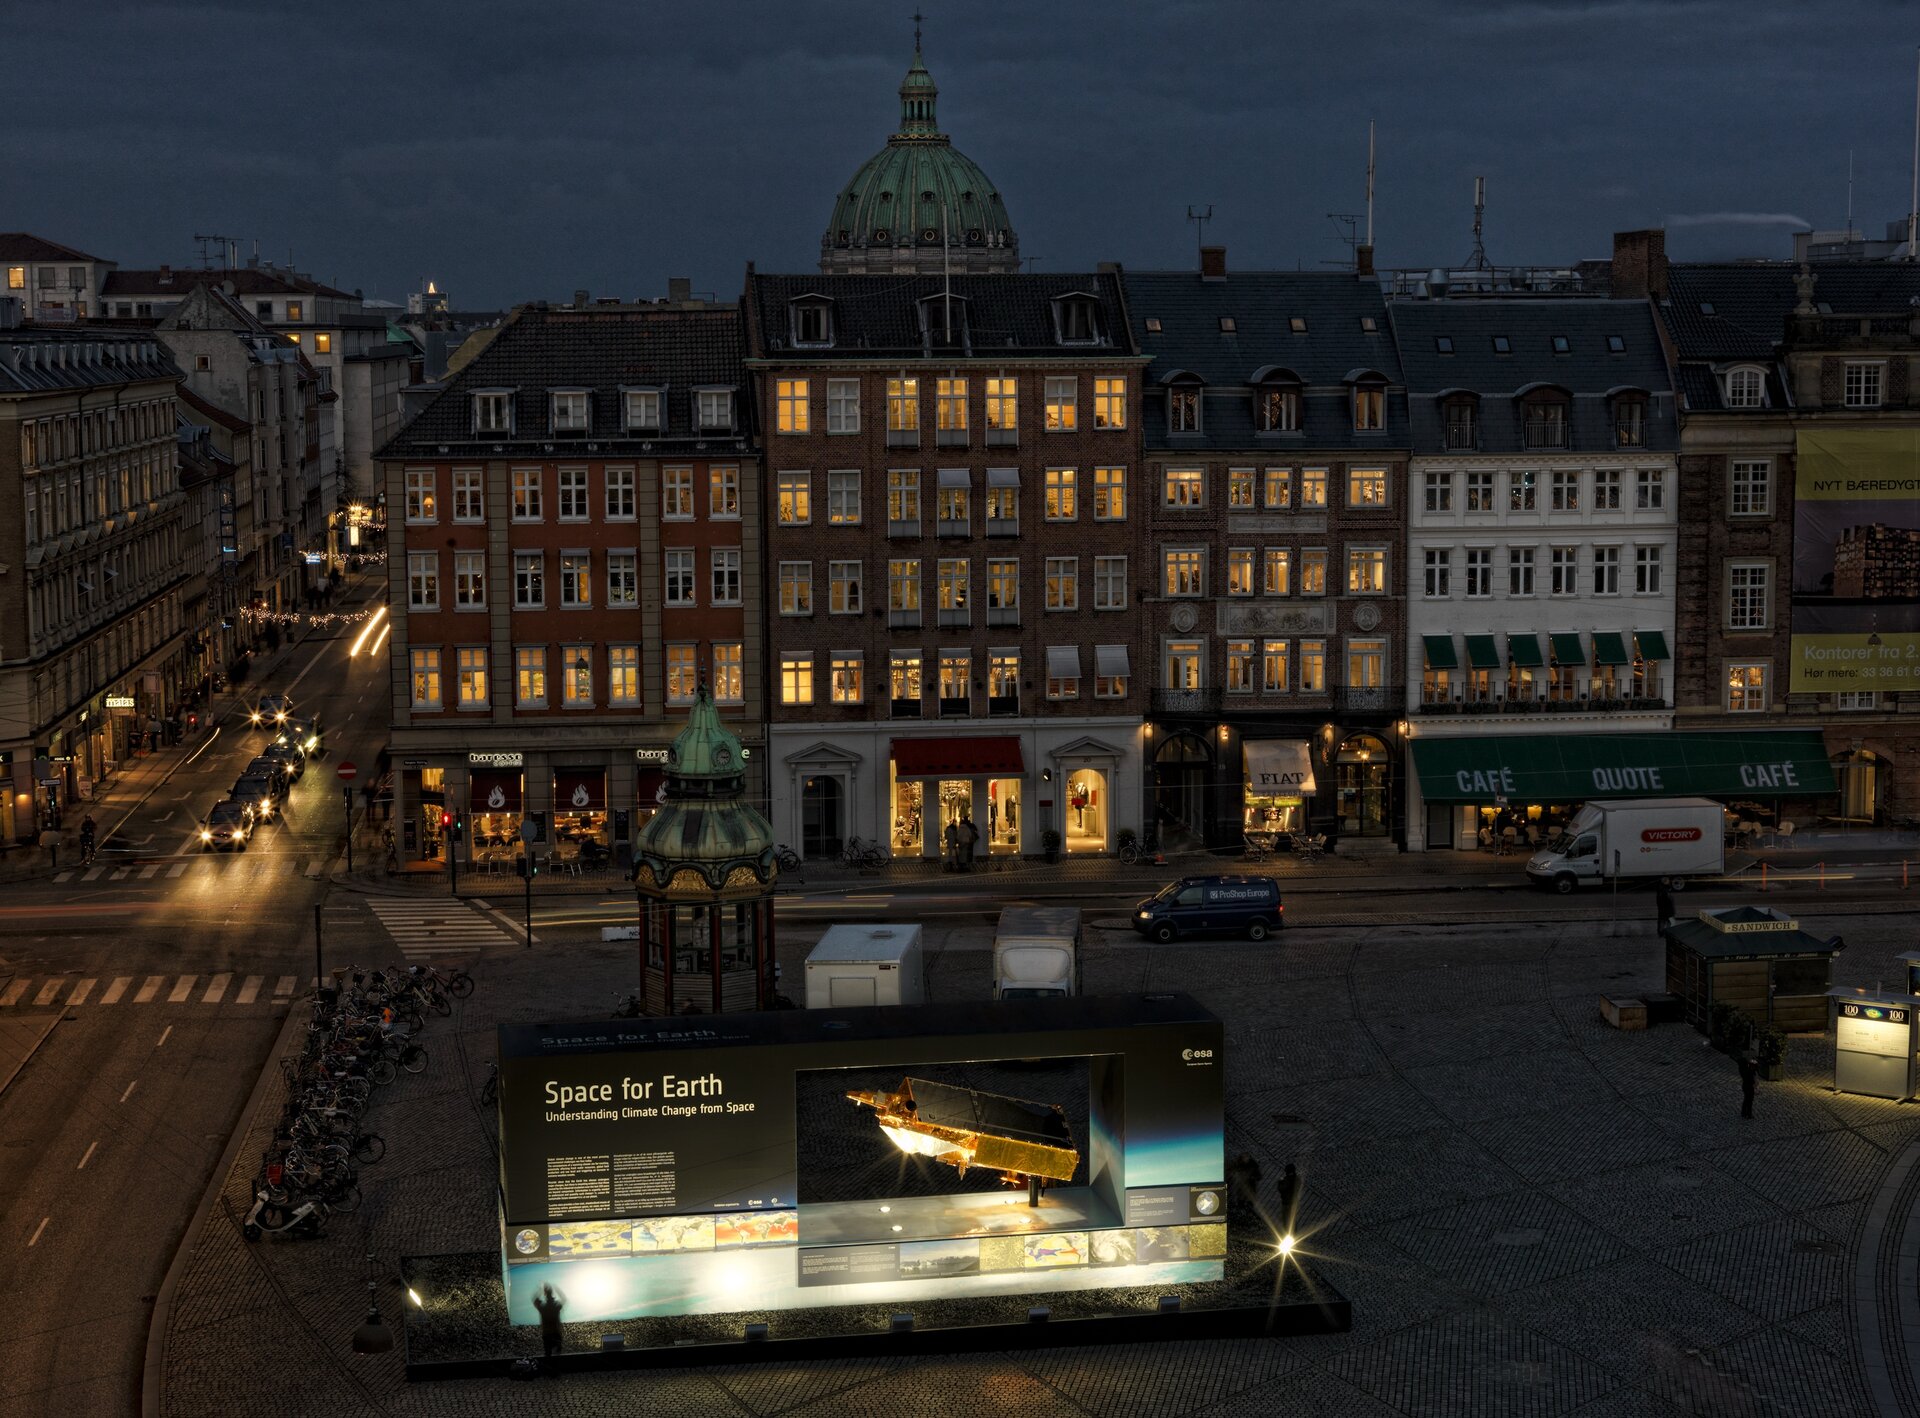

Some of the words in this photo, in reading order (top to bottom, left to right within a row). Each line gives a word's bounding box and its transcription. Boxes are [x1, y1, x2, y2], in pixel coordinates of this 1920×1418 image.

[1814, 480, 1842, 491] NYT
[1804, 645, 1873, 660] Kontorer
[1878, 645, 1900, 659] fra
[1804, 668, 1824, 678] Hør
[1828, 669, 1858, 678] mere:
[1862, 667, 1876, 678] 33
[1880, 666, 1893, 677] 36
[1896, 666, 1908, 677] 61
[105, 697, 135, 708] matas
[469, 752, 523, 763] baresso
[637, 749, 669, 759] bare
[1259, 772, 1304, 785] FIAT
[1456, 766, 1516, 793] CAFÉ
[1592, 767, 1664, 791] QUOTE
[1739, 760, 1799, 788] CAFÉ
[1647, 830, 1697, 840] VICTORY
[1219, 889, 1247, 899] ProShop
[1247, 888, 1270, 899] Europe
[1731, 921, 1791, 932] SANDWICH
[1844, 1004, 1859, 1016] 100
[1889, 1010, 1904, 1021] 100
[544, 1081, 612, 1108] Space
[621, 1077, 653, 1100] for
[663, 1073, 723, 1098] Earth
[545, 1109, 619, 1122] Understanding
[621, 1107, 658, 1119] Climate
[661, 1105, 697, 1117] Change
[700, 1103, 723, 1114] from
[726, 1102, 755, 1113] Space
